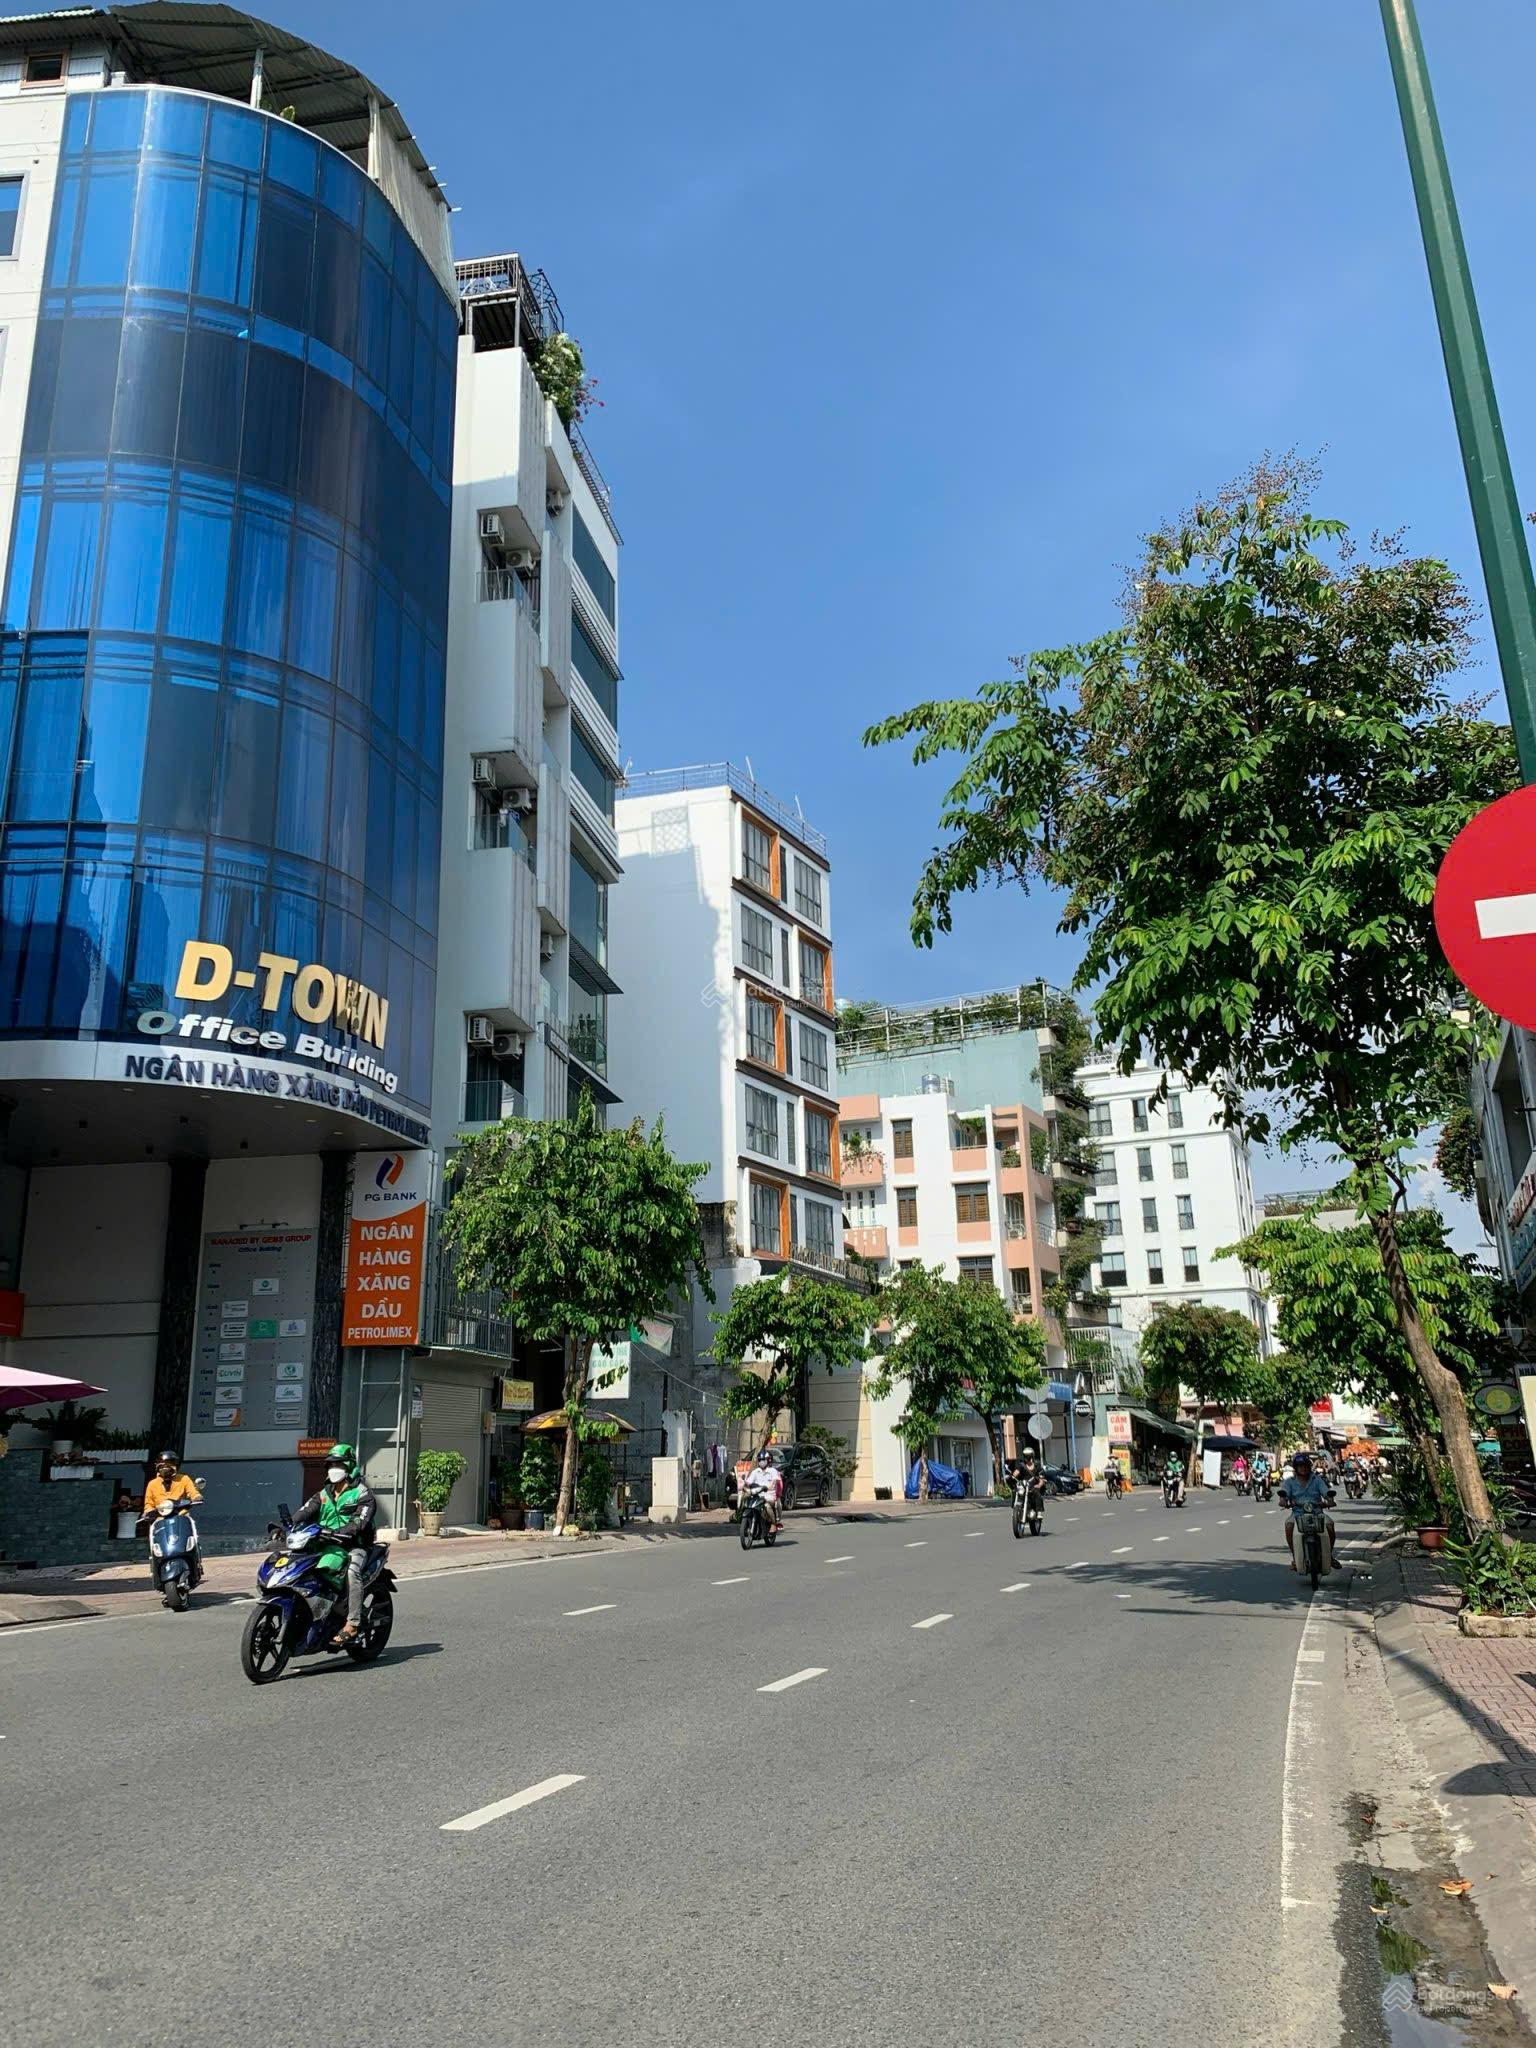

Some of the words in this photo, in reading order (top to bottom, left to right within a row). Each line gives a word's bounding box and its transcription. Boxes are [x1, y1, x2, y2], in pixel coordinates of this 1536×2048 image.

[175, 940, 388, 1050] D-TOWN
[137, 1010, 286, 1050] Office
[294, 1033, 398, 1094] Building
[125, 1053, 204, 1083] NGÂN
[211, 1057, 280, 1093] HÀNG
[286, 1072, 340, 1107] XĂNG
[364, 1194, 381, 1202] PG
[383, 1192, 418, 1202] BANK
[360, 1222, 413, 1241] NGÂN
[359, 1247, 412, 1266] HÀNG
[356, 1272, 411, 1291] XĂNG
[361, 1297, 402, 1319] DẦU
[348, 1326, 412, 1339] PETROLIMEX
